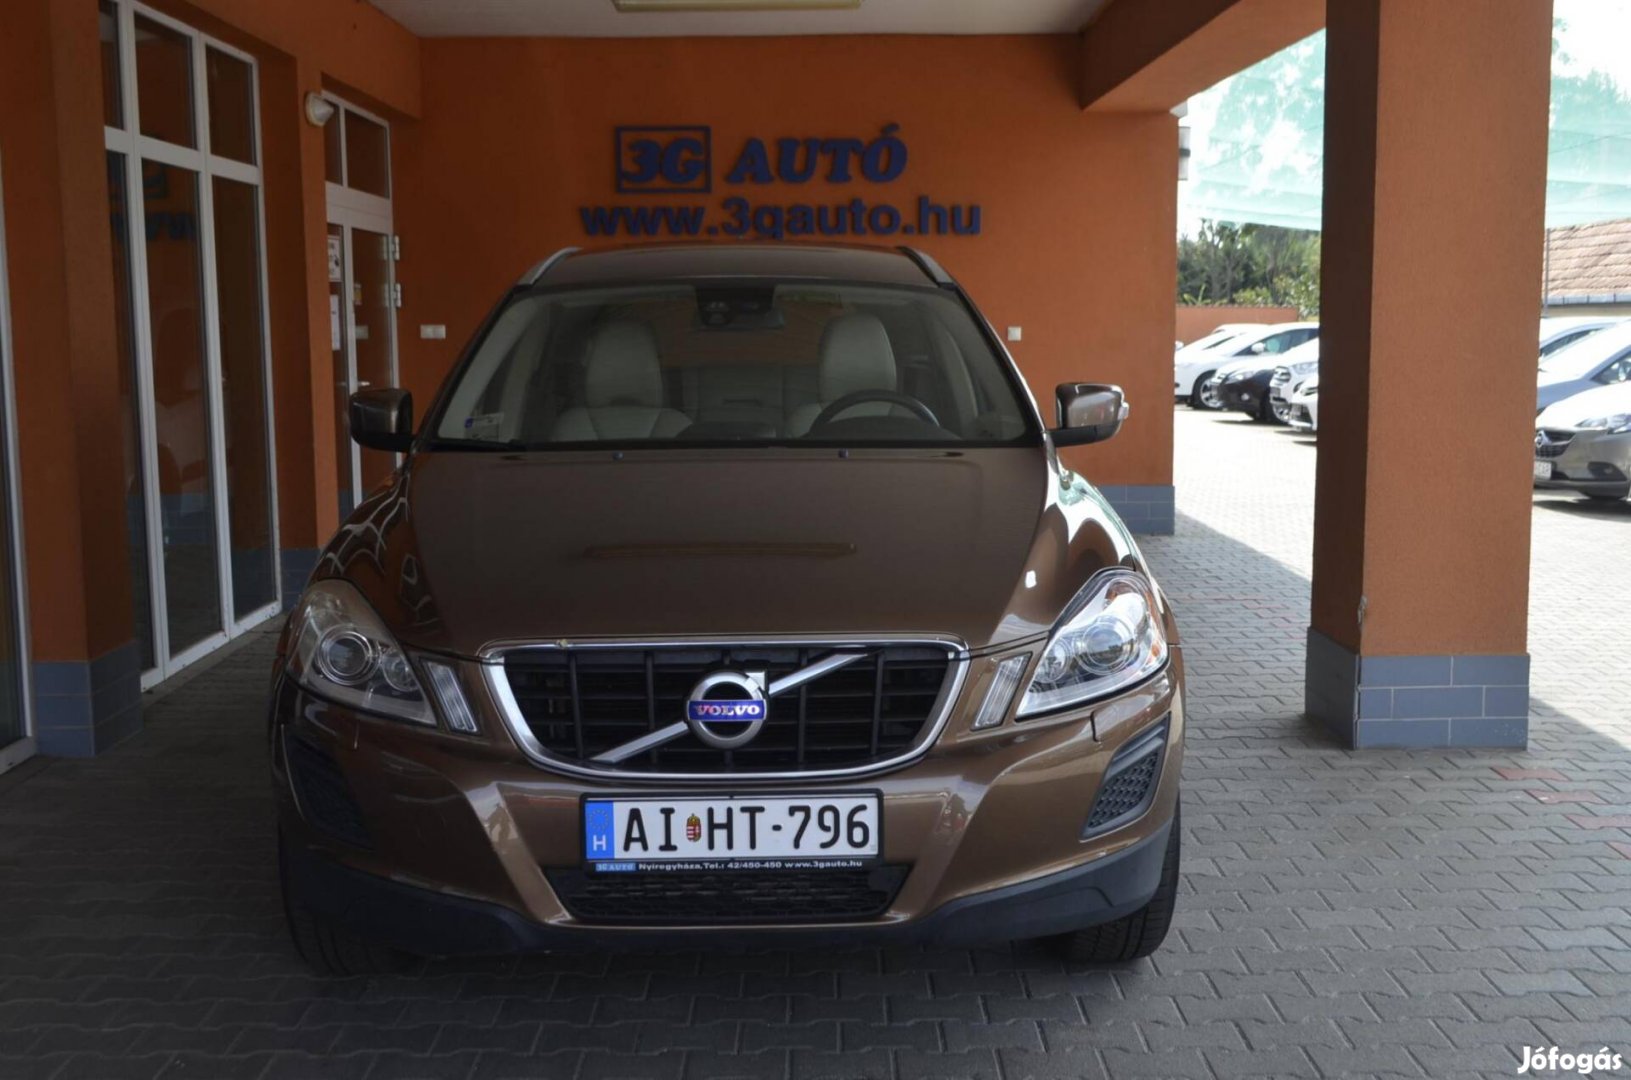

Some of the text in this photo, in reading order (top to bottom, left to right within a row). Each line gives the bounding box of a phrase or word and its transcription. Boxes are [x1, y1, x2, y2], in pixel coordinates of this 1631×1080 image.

[621, 123, 908, 184] 3G AUTÓ
[696, 704, 761, 716] VOLVO
[593, 834, 606, 851] H
